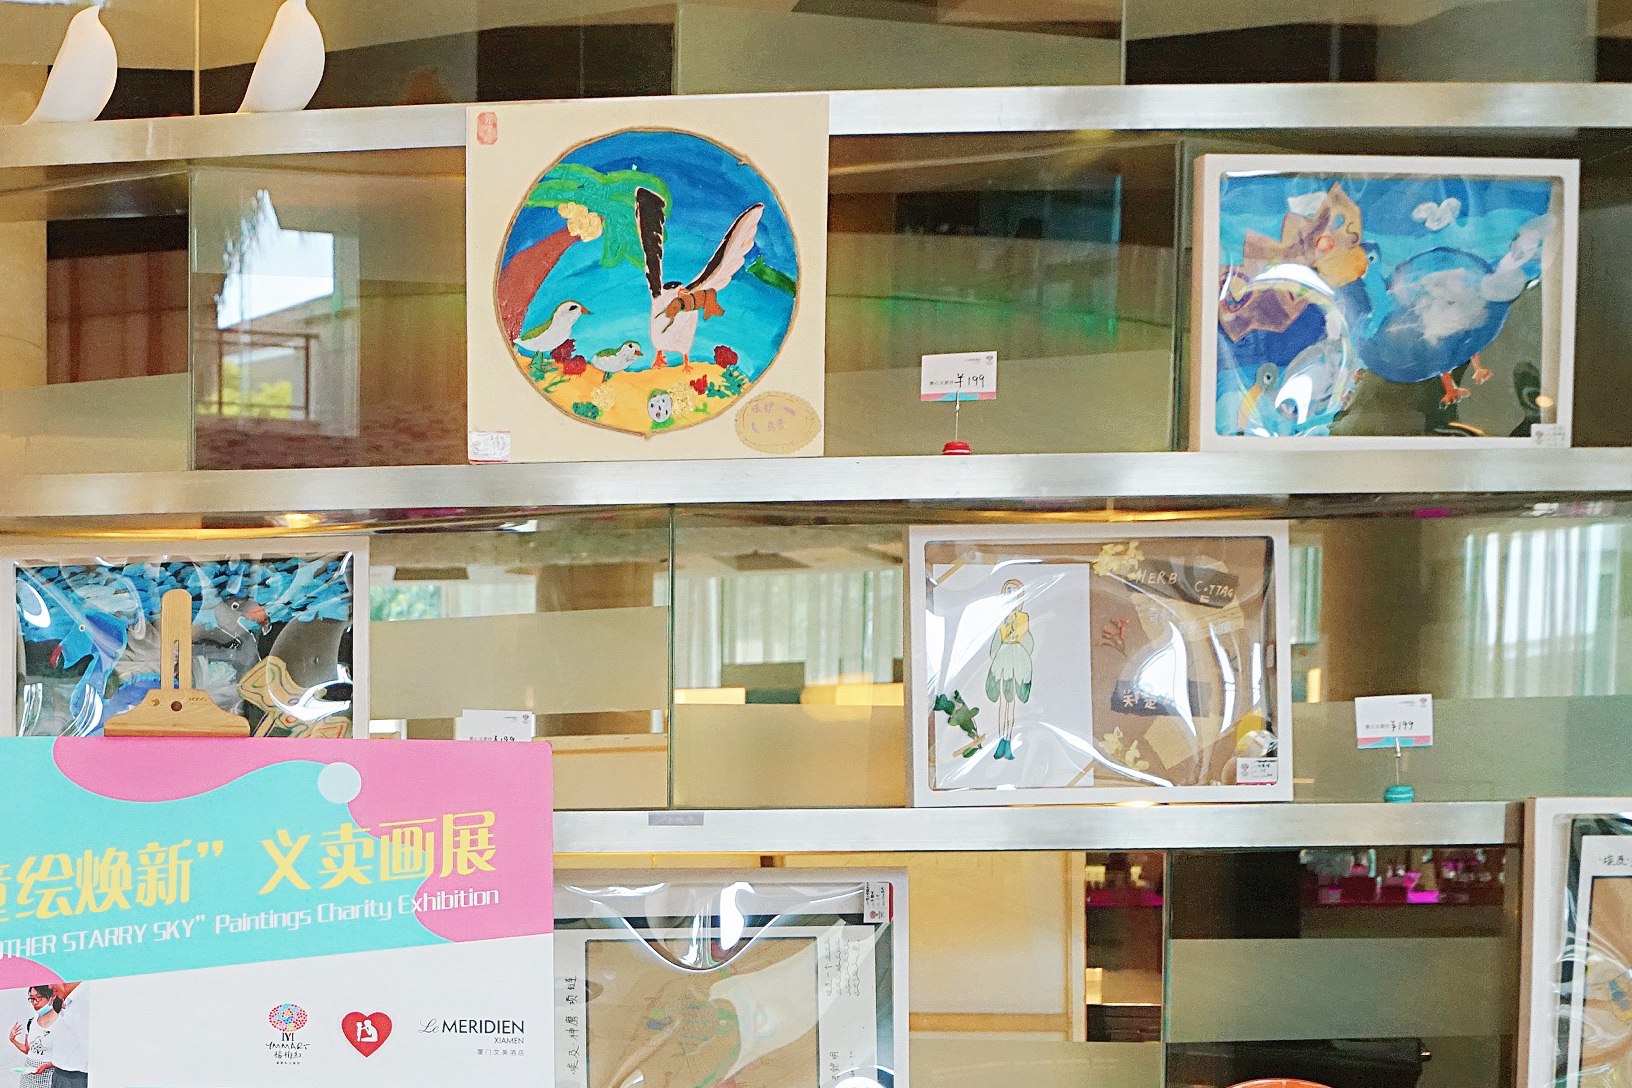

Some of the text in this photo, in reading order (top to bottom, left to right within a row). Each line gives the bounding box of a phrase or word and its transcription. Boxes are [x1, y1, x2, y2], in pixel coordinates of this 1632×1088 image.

[258, 810, 498, 896] 义卖画展
[63, 924, 147, 952] STARRY
[215, 908, 312, 935] Paintings
[318, 899, 392, 923] Charity
[398, 888, 499, 914] Exhibition
[418, 1018, 525, 1035] Le MERIDIEN
[494, 1037, 524, 1045] XIAMEN
